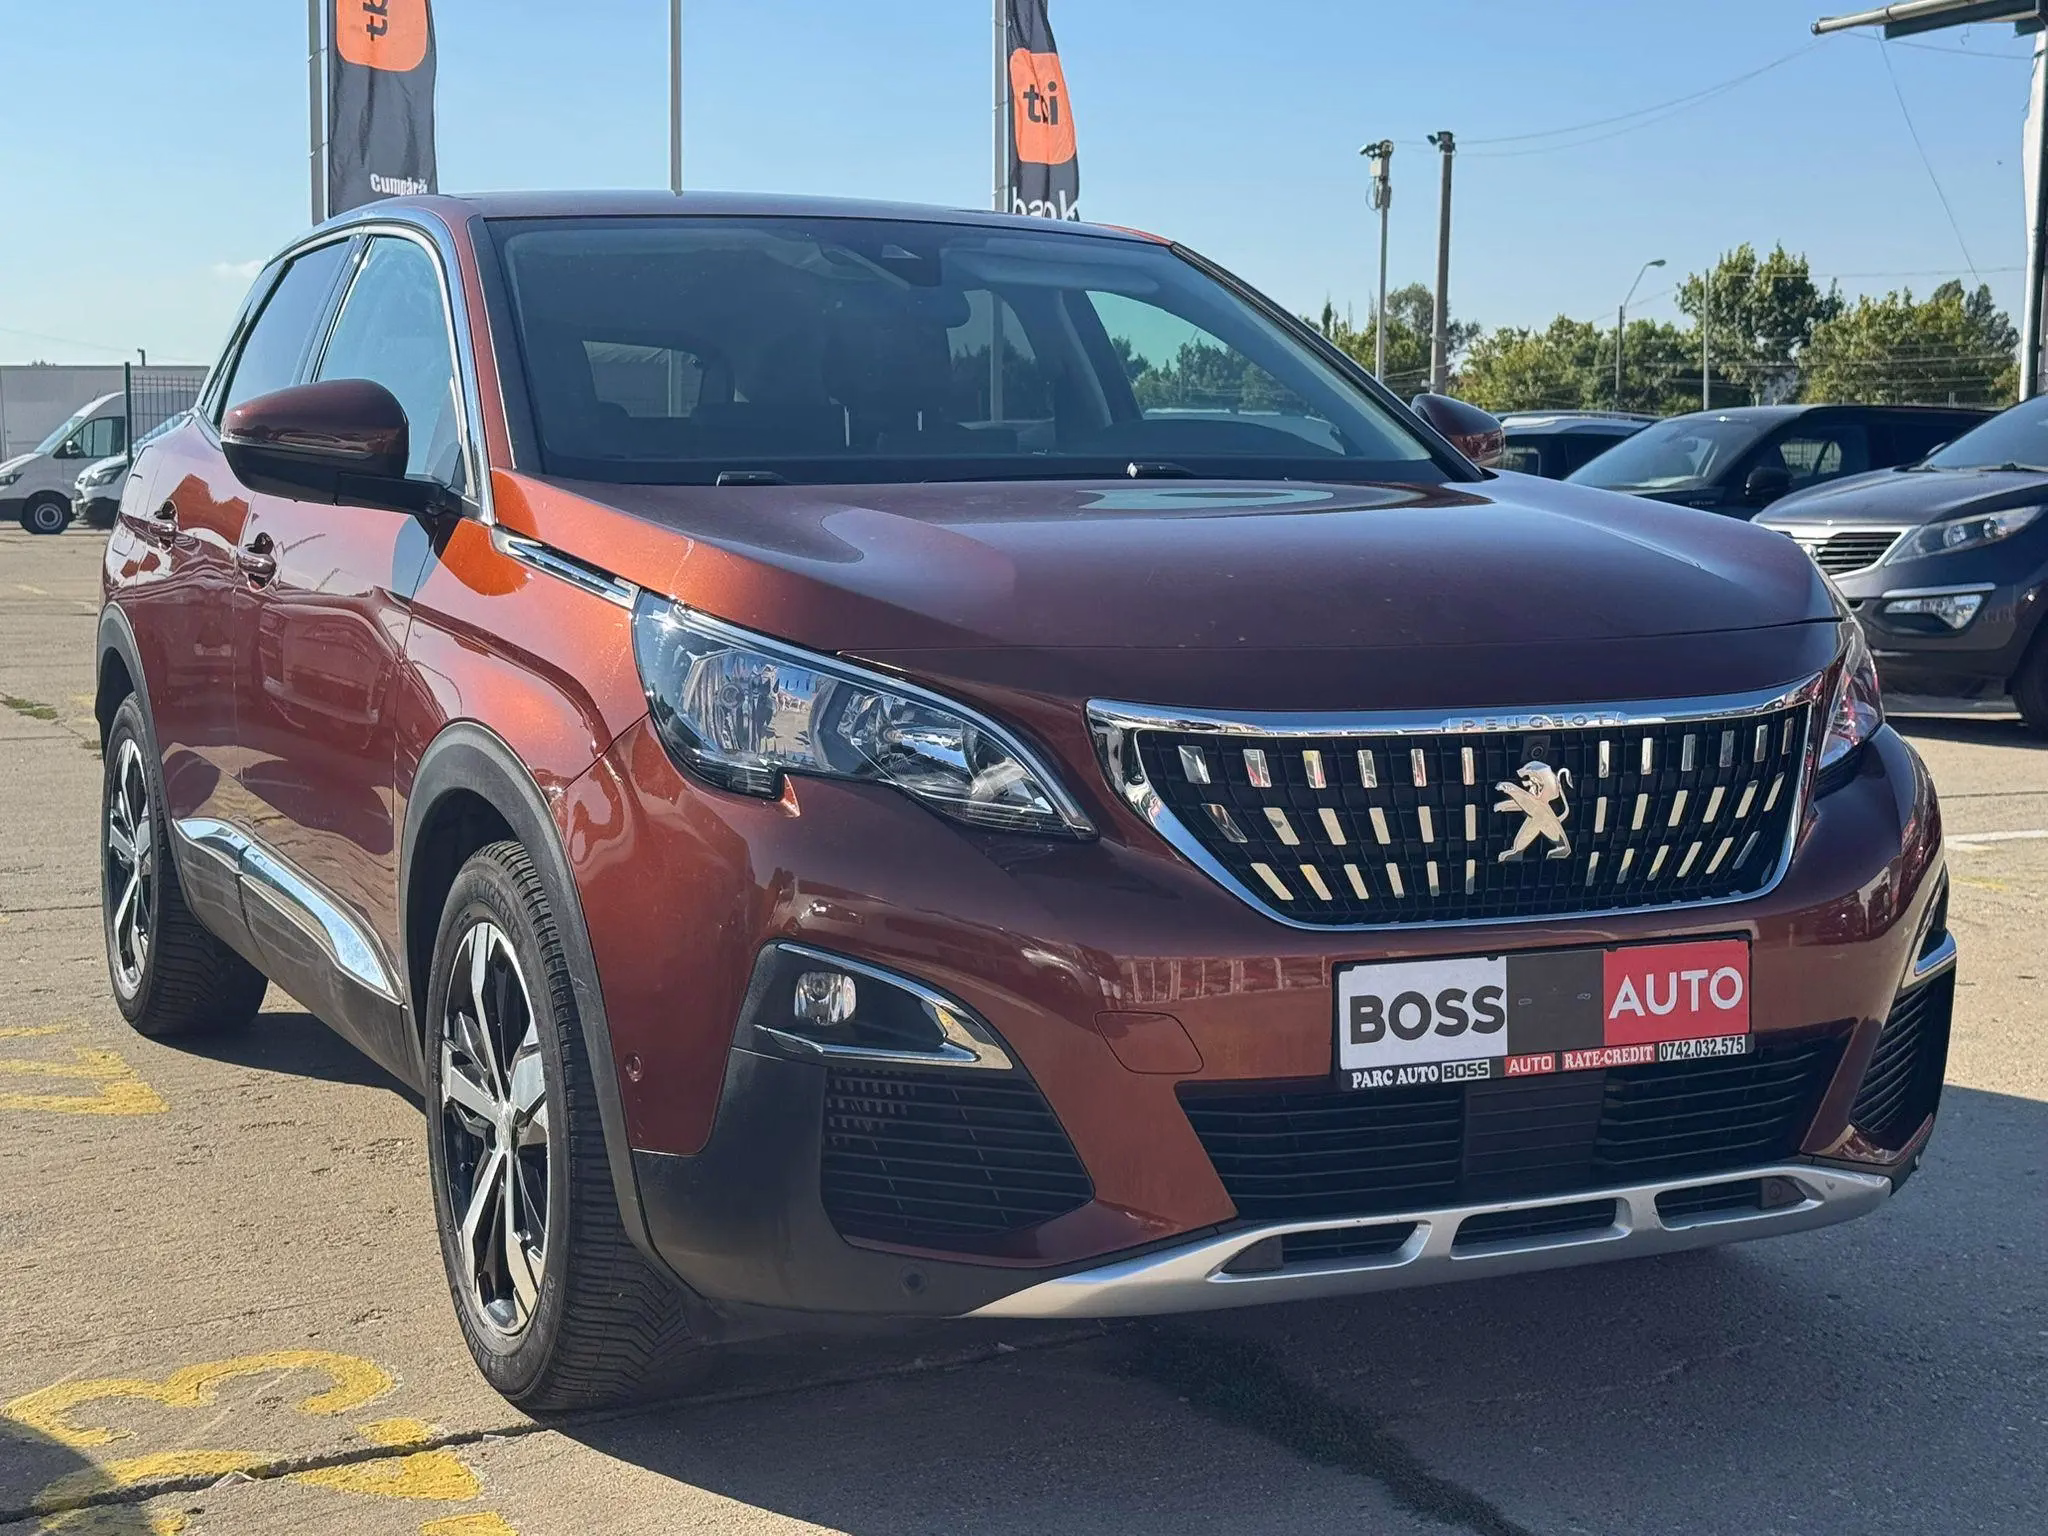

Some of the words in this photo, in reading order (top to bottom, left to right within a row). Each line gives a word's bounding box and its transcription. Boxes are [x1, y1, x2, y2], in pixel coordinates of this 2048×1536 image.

[1461, 713, 1608, 731] PEUGEOT
[1349, 985, 1506, 1046] BOSS
[1608, 966, 1743, 1020] AUTO
[1351, 1069, 1394, 1089] PARC
[1396, 1064, 1440, 1086] AUTO
[1443, 1061, 1489, 1080] BOSS
[1508, 1055, 1553, 1074] AUTO
[1563, 1044, 1655, 1069] RATE-CREDIT
[1660, 1036, 1745, 1060] 0742.032.575
